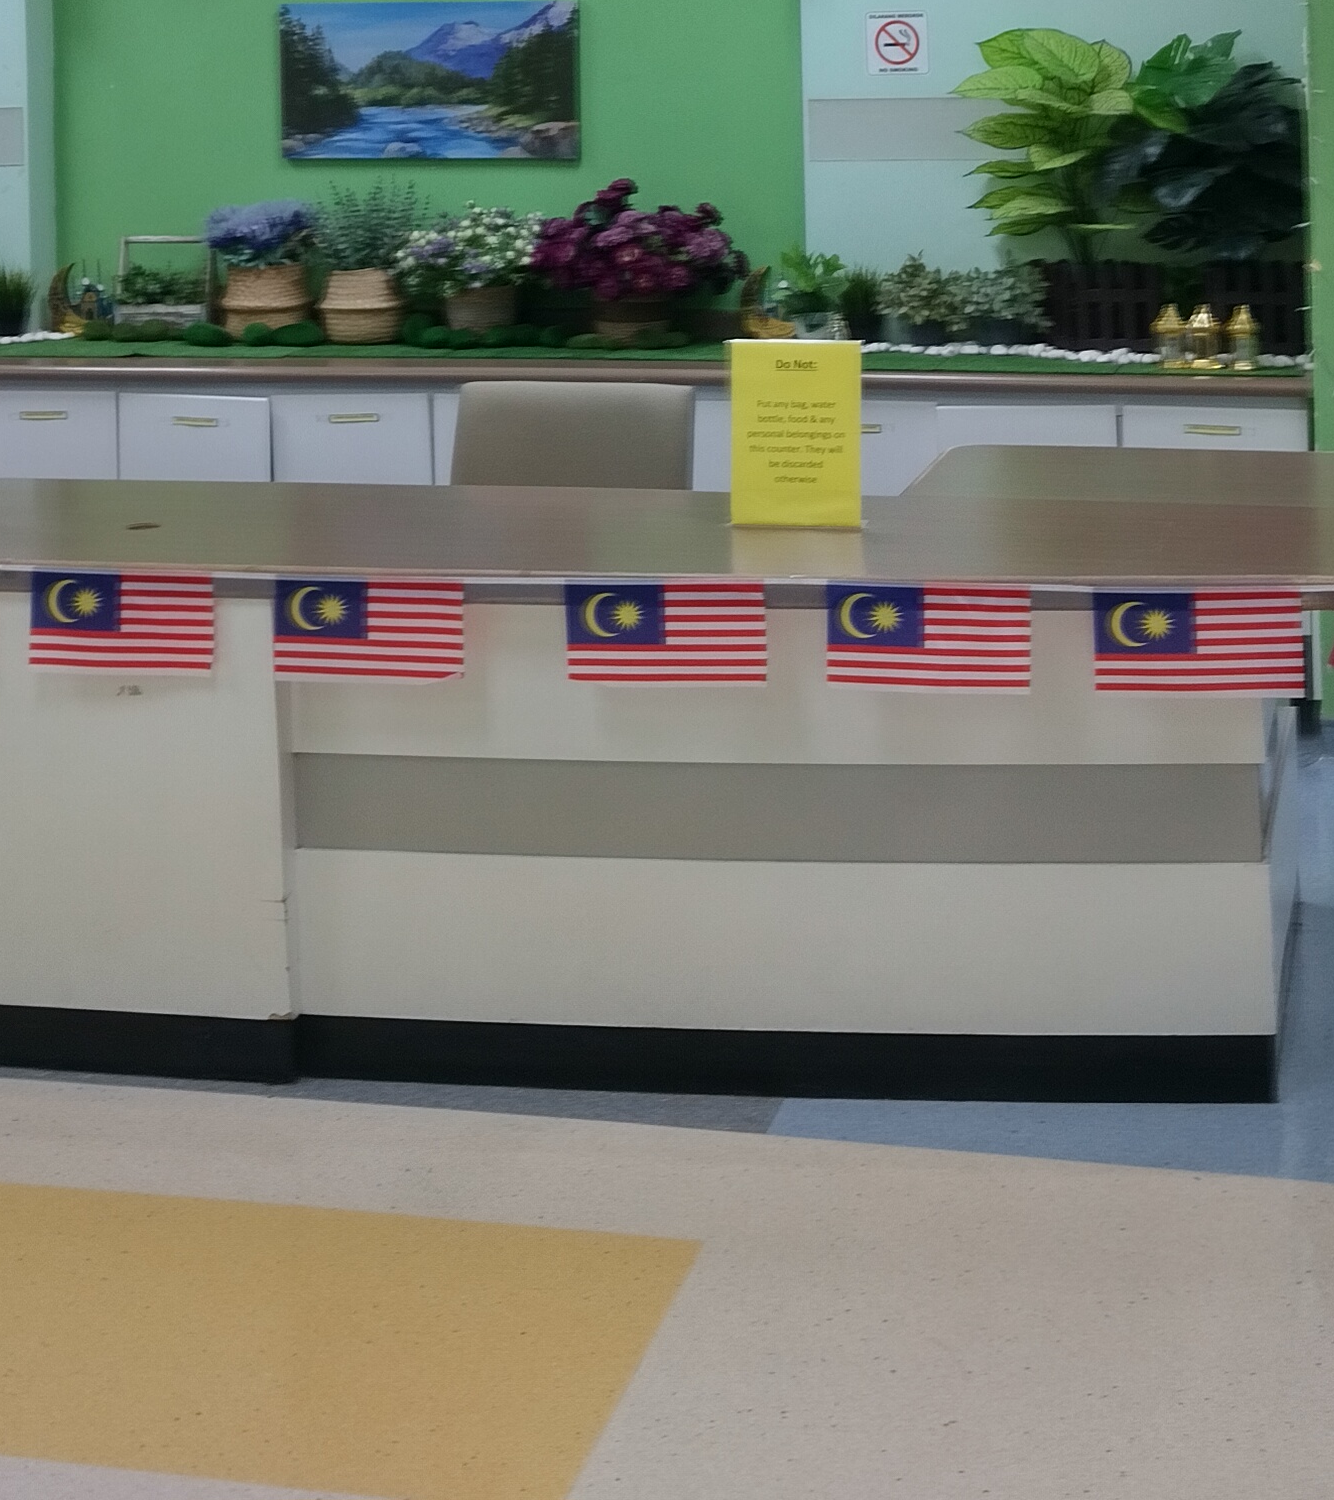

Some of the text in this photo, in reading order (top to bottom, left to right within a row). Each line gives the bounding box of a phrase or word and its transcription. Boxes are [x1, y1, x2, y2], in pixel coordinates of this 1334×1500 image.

[775, 359, 818, 369] Do Not:
[787, 415, 808, 423] food
[819, 417, 836, 425] any
[747, 430, 784, 439] personal
[785, 431, 832, 440] belongings
[805, 444, 826, 455] They
[768, 460, 824, 468] be discarded
